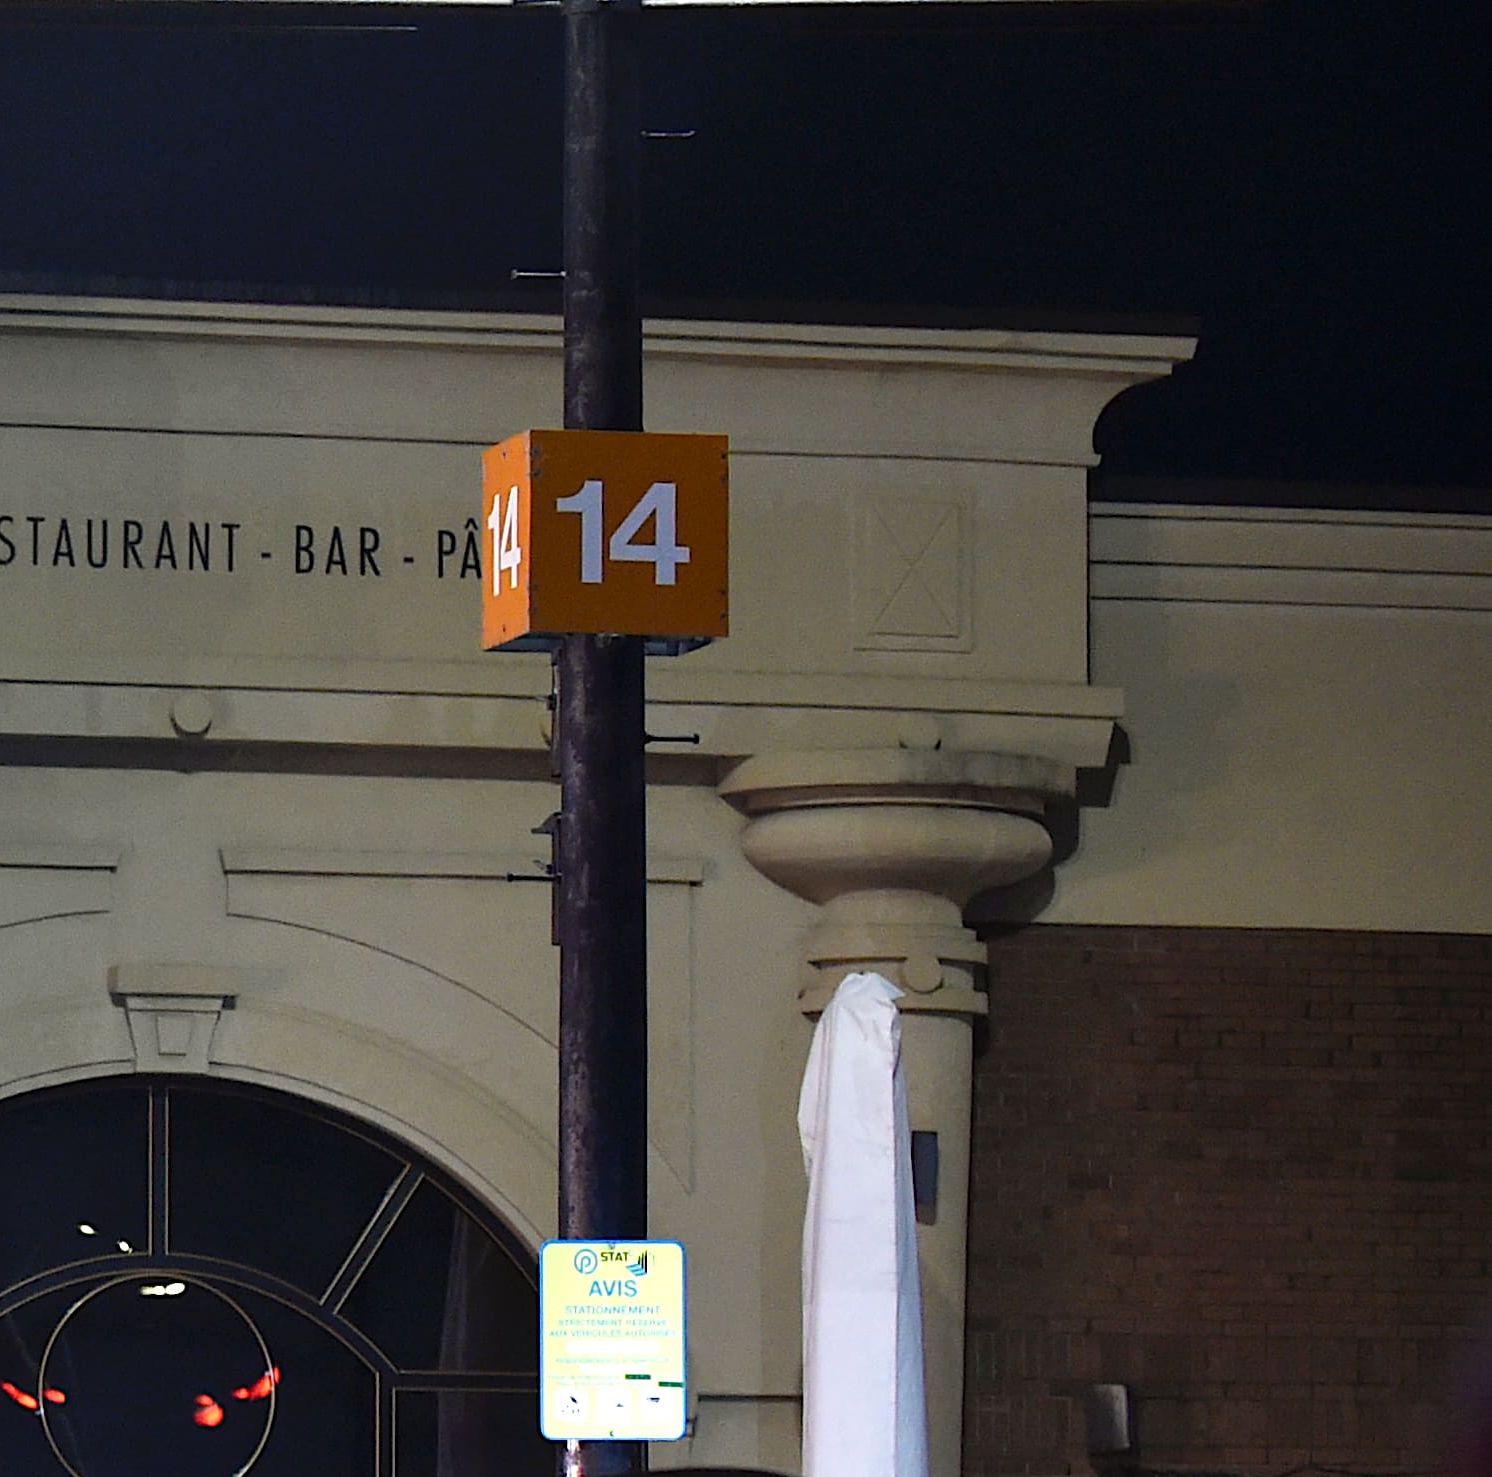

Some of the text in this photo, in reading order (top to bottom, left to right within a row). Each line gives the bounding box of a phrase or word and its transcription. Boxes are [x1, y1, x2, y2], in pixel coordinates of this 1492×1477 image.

[294, 524, 381, 577] BAR
[487, 485, 522, 597] 14
[556, 480, 691, 586] 14
[588, 1280, 638, 1298] AVIS
